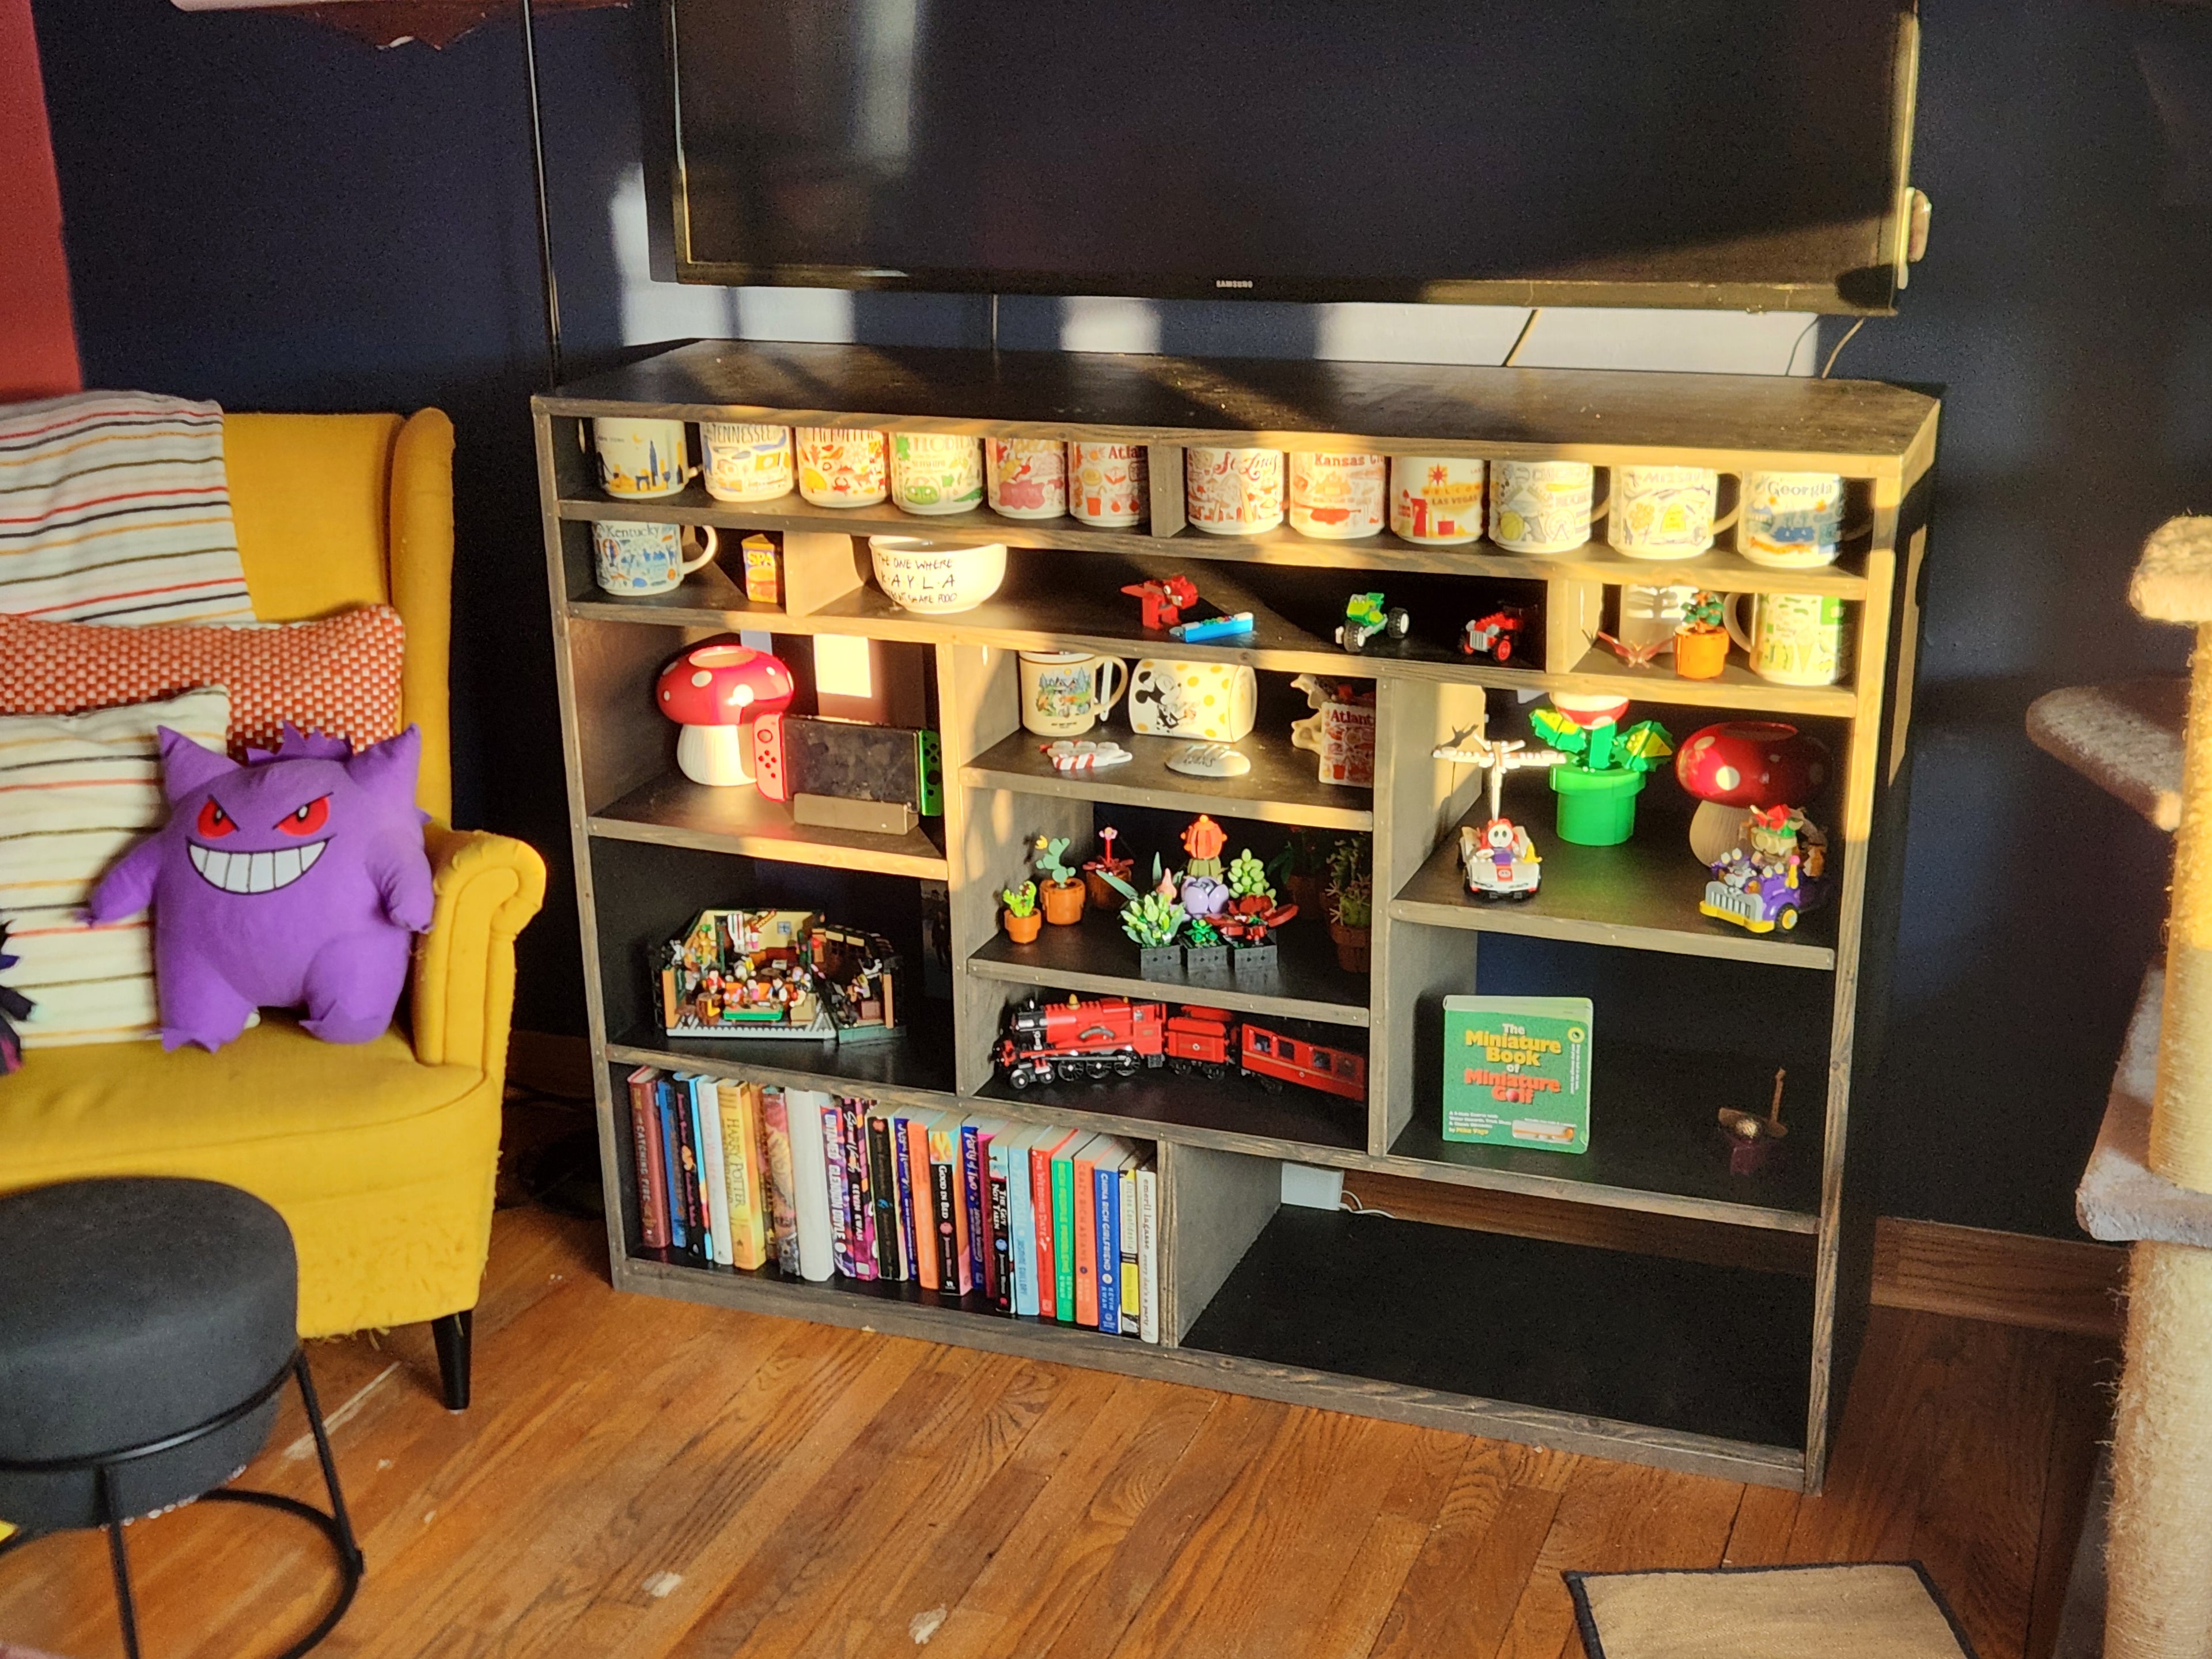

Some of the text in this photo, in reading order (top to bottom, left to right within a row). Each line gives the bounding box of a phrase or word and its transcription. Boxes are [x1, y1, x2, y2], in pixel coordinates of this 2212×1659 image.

[1216, 280, 1253, 288] SAMSUNG
[713, 423, 772, 444] TENNESSEE
[1315, 453, 1365, 467] Kansas
[1451, 494, 1478, 505] VEGAS
[1768, 481, 1833, 498] Georgia
[605, 522, 660, 539] Kentucky
[877, 553, 953, 571] THE ONE WHERE
[938, 593, 957, 603] FOOD
[1502, 1023, 1525, 1035] The
[1465, 1030, 1562, 1054] Miniature
[1485, 1046, 1541, 1066] Book
[1506, 1064, 1521, 1073] of
[1464, 1068, 1562, 1093] Miniature
[1491, 1085, 1535, 1104] Golf
[636, 1125, 649, 1175] CATCHING
[964, 1132, 978, 1161] Party
[726, 1118, 746, 1208] HARRY POTTER
[824, 1114, 846, 1240] UNTAMED GLENNON DOYLE
[967, 1171, 979, 1191] Two
[938, 1165, 950, 1219] GOOD IN BED
[1036, 1171, 1047, 1213] WEDDING
[1143, 1179, 1152, 1211] emeril
[851, 1184, 863, 1241] KEVIN KWAN
[991, 1183, 1001, 1230] NOT TAKEN
[998, 1190, 1007, 1226] THE GUY
[1077, 1164, 1088, 1262] CRAZY RICH ASIANS
[1126, 1180, 1135, 1252] Kitchen Confidential
[1039, 1213, 1048, 1237] DATE
[1100, 1173, 1111, 1271] CHINA RICH GIRLFRIEND
[1142, 1214, 1152, 1250] lagasse
[1018, 1267, 1028, 1296] GUILLORY
